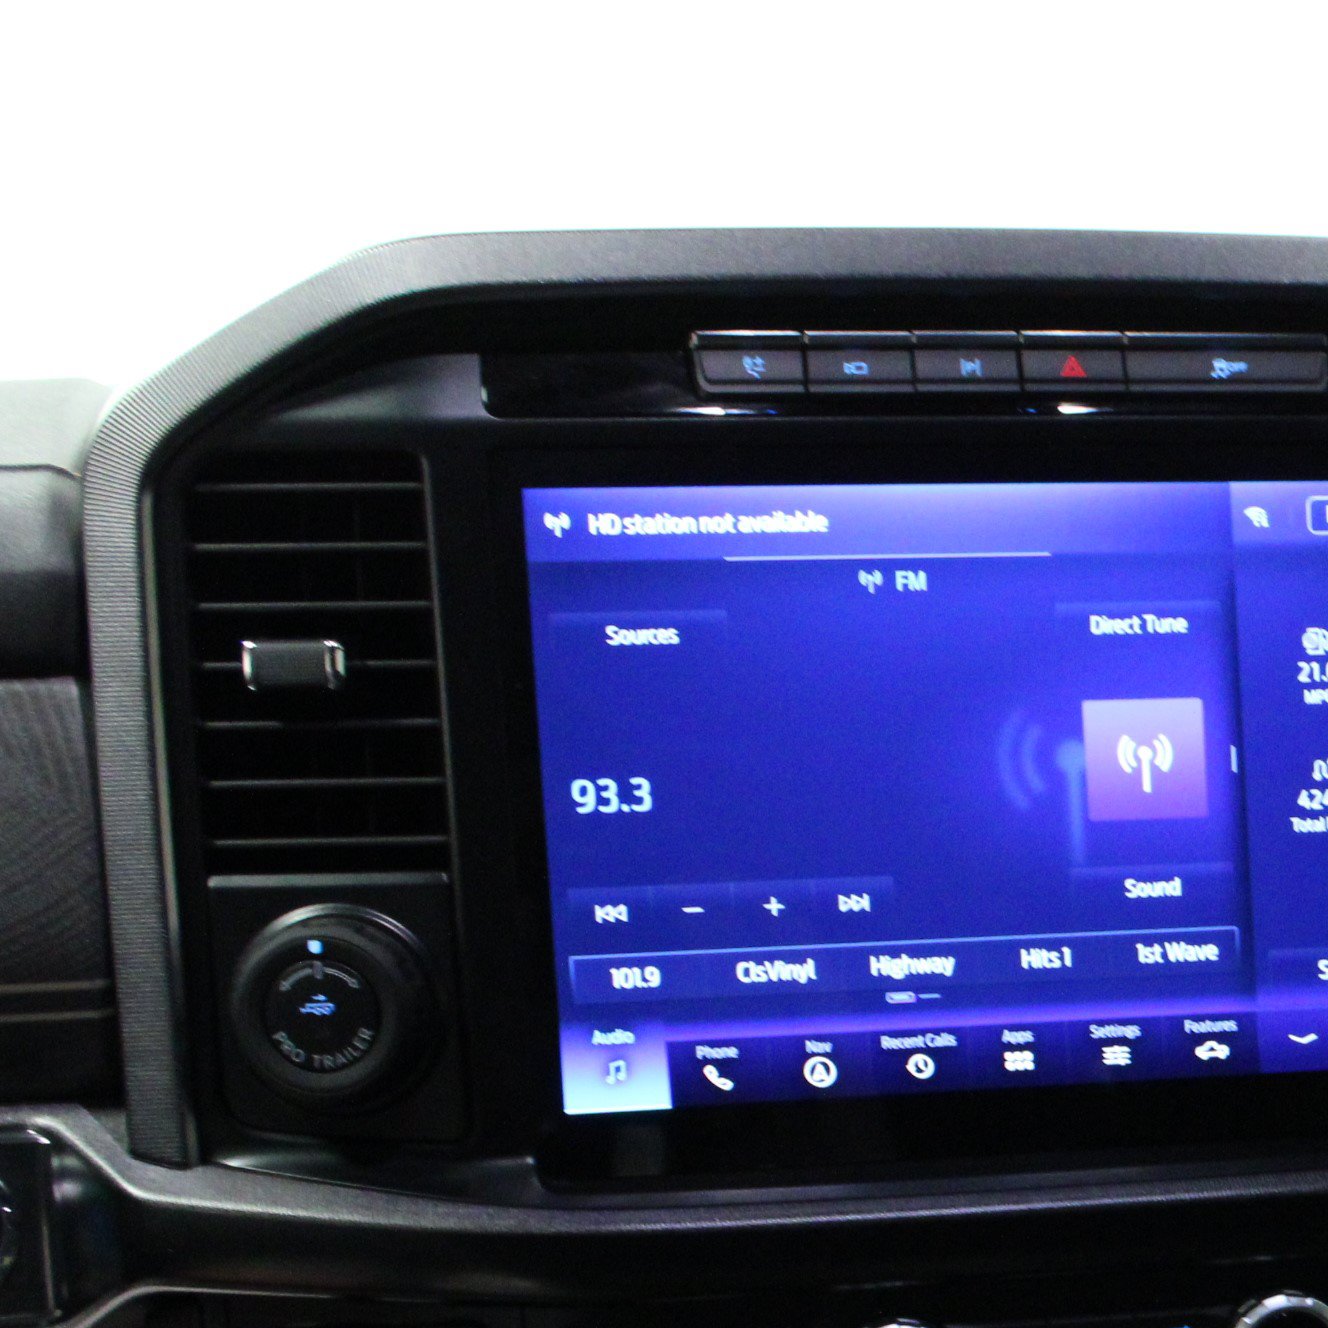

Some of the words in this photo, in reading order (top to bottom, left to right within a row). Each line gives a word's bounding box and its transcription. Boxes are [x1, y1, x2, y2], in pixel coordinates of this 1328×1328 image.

[588, 513, 621, 536] HD
[623, 513, 698, 536] station
[699, 512, 735, 535] not
[737, 511, 828, 534] available
[895, 570, 928, 592] FM
[605, 625, 680, 646] Sources
[1089, 614, 1140, 636] Direct
[1142, 613, 1188, 635] Tune
[570, 777, 653, 814] 93.3
[1290, 816, 1326, 833] Total
[1124, 877, 1182, 899] Sound
[1135, 943, 1161, 965] 1st
[1163, 941, 1220, 963] Wave
[609, 966, 662, 990] 101.9
[735, 958, 817, 985] ClsVinyl
[869, 954, 955, 980] Highway
[591, 1028, 636, 1046] Audio
